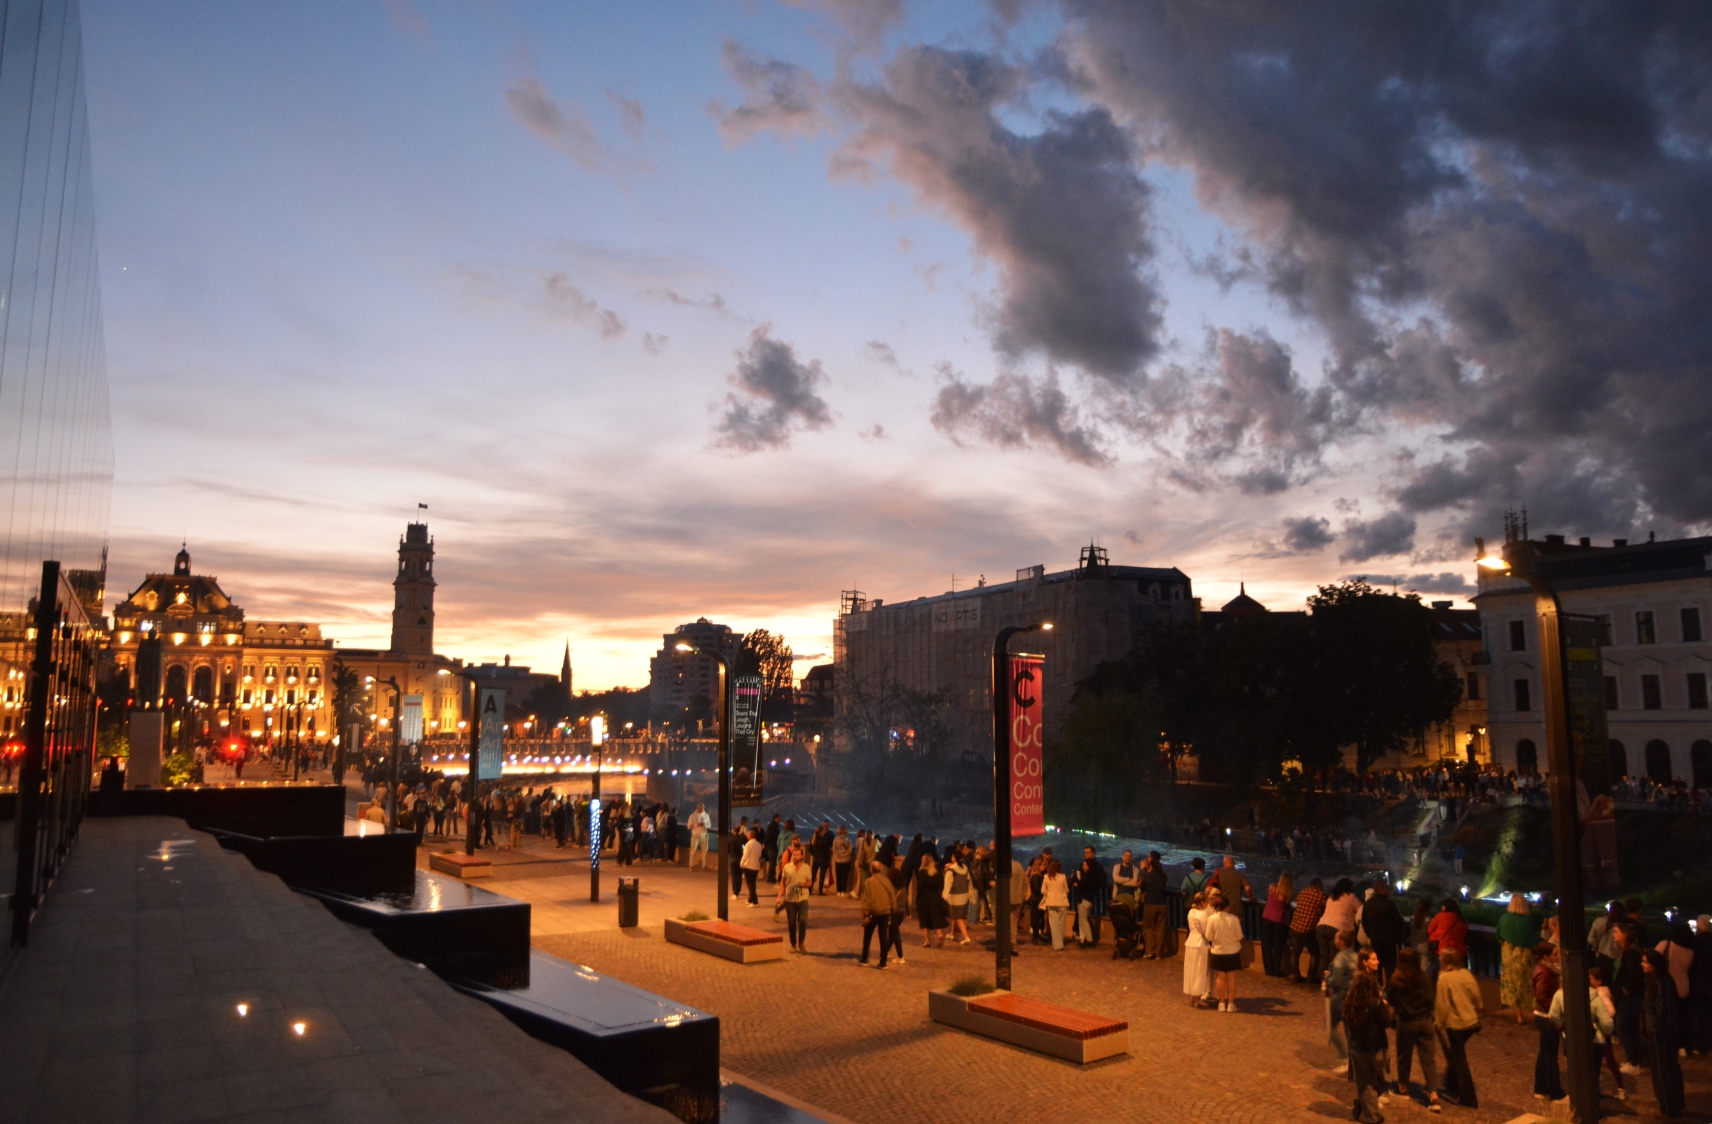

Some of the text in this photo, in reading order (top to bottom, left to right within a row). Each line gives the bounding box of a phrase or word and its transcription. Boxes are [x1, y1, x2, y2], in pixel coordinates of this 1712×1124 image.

[1013, 670, 1035, 708] C
[483, 694, 498, 714] A
[1013, 781, 1043, 800] Con
